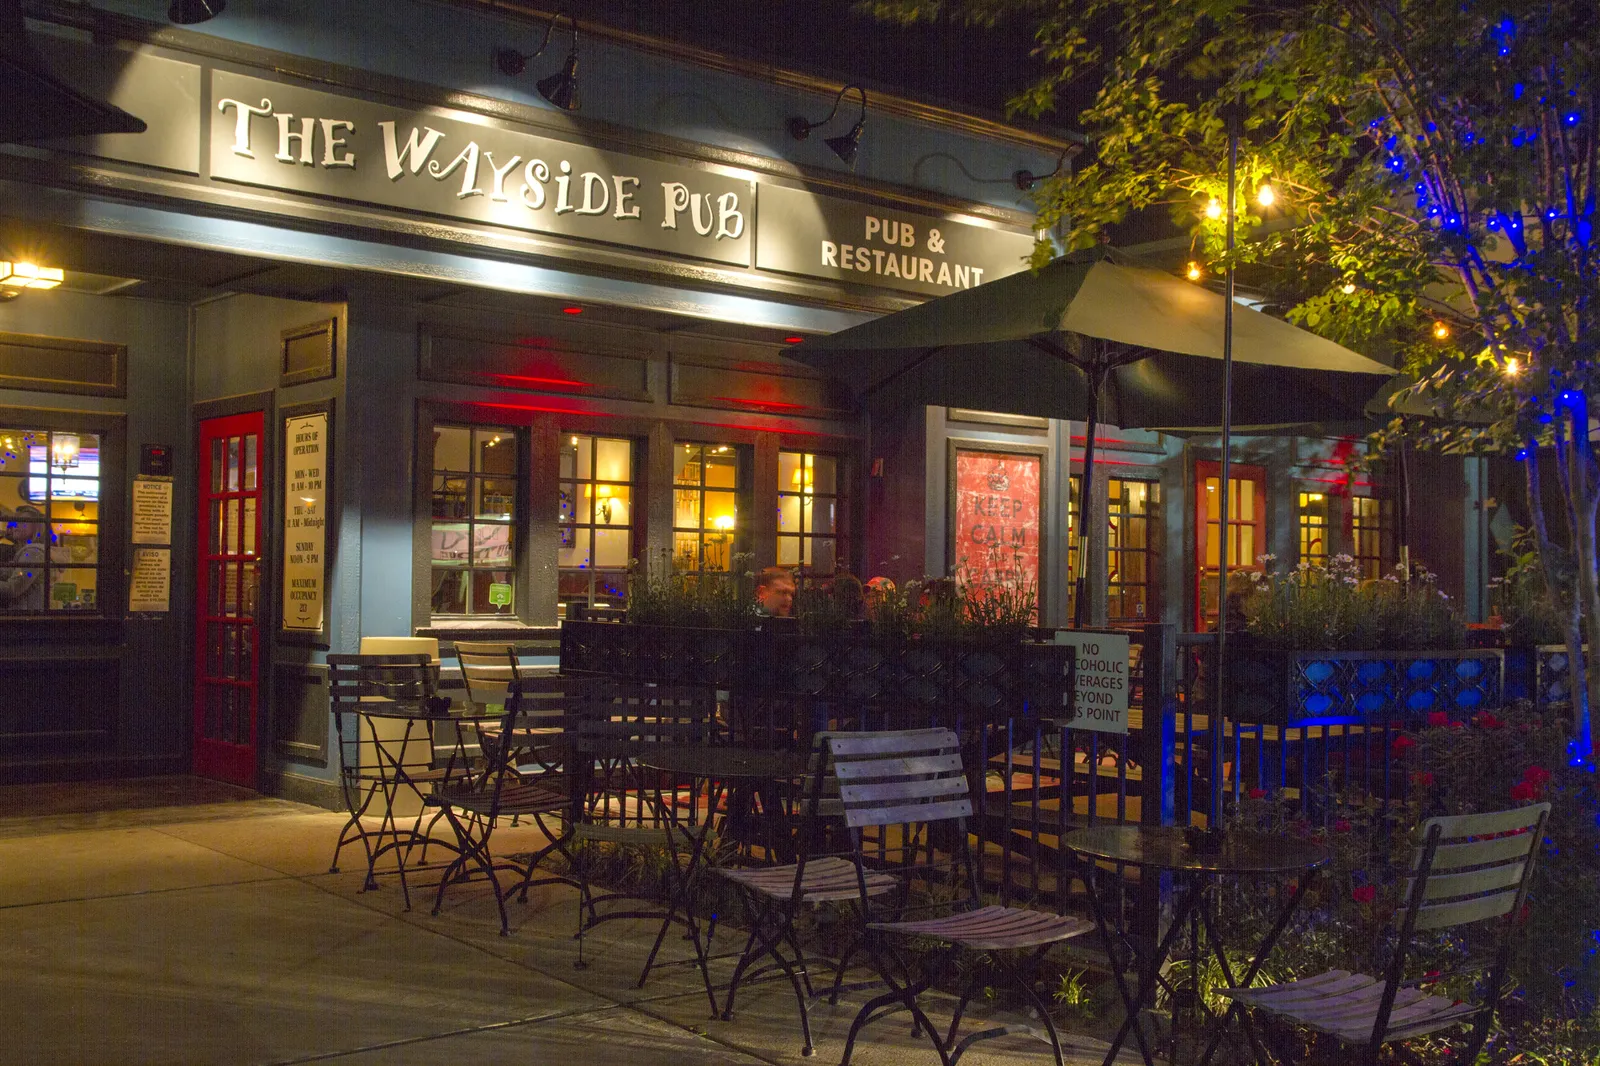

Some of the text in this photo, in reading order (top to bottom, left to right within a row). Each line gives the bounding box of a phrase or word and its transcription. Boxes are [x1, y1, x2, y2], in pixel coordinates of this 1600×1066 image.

[218, 97, 356, 168] THE
[661, 181, 744, 240] PUB
[865, 215, 945, 254] PUB &
[821, 240, 984, 290] RESTAURANT
[296, 431, 318, 443] HOURS OF
[293, 443, 319, 455] OPERATION
[295, 469, 305, 479] MON
[308, 468, 319, 478] WED
[296, 482, 304, 490] AM
[308, 482, 313, 490] 10
[314, 480, 322, 489] PM
[974, 495, 1022, 518] KEEP
[292, 519, 300, 527] AM
[971, 525, 1025, 545] CALM
[296, 542, 314, 551] SUNDAY
[290, 555, 304, 563] NOON
[311, 554, 319, 563] PM
[292, 579, 317, 588] MAXIMUM
[290, 591, 317, 600] OCCUPANCY
[1082, 643, 1099, 655] NO
[1075, 659, 1124, 673] COHOLIC
[1075, 690, 1113, 705] EYOND
[1087, 707, 1120, 722] POINT
